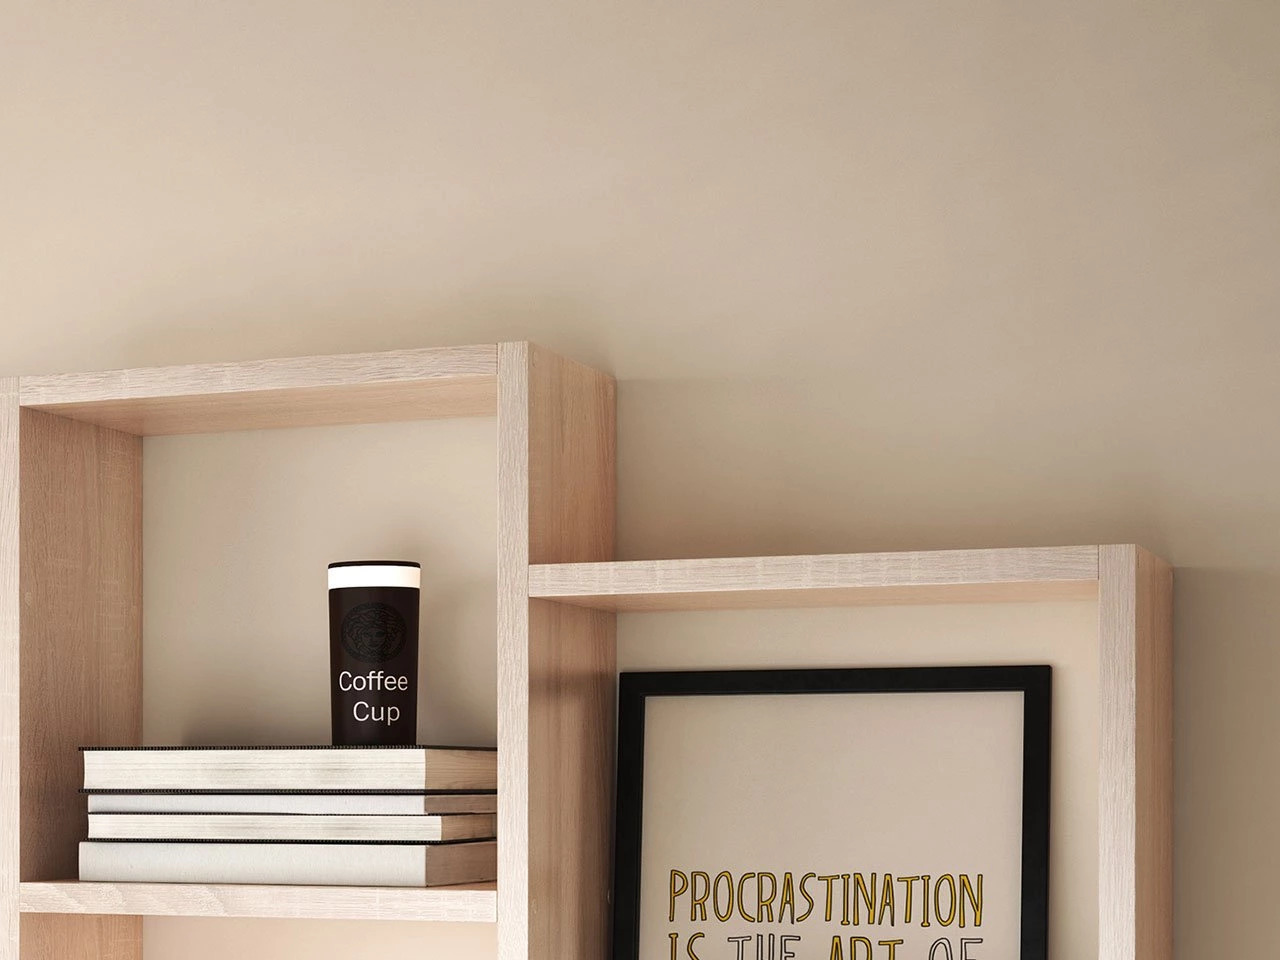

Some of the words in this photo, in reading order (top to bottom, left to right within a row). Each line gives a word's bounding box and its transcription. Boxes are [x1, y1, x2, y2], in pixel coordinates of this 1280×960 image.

[339, 670, 408, 691] Coffee
[353, 701, 400, 726] Cup
[669, 869, 983, 928] PROCRASTINATION
